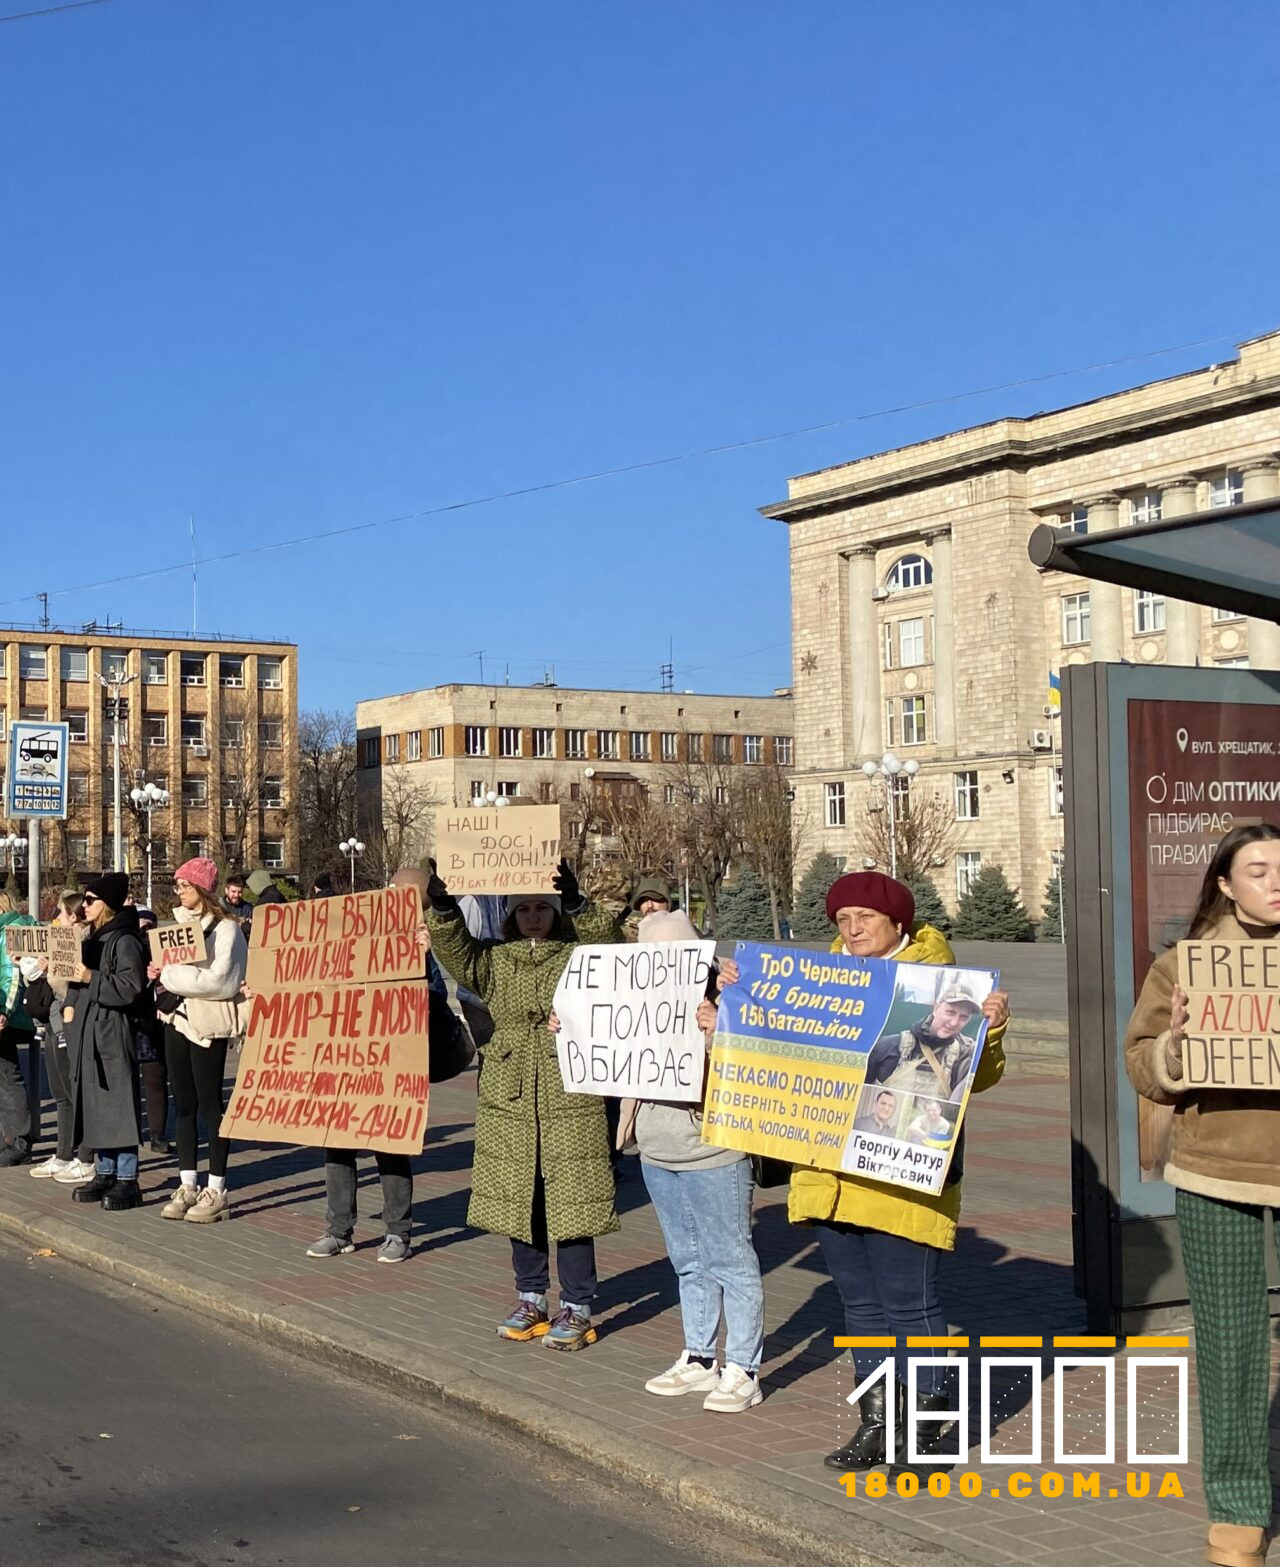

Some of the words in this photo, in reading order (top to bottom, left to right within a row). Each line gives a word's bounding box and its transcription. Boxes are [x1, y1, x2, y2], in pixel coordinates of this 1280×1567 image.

[1191, 741, 1216, 754] ВУЛ.
[1218, 741, 1276, 756] ХРЕЩАТИК,
[34, 800, 41, 808] 10
[1173, 781, 1205, 805] ДІМ
[447, 809, 498, 833] НАШІ
[480, 826, 533, 850] ДОСІ
[1148, 812, 1234, 836] ПІДБИРАЄ
[449, 853, 465, 870] В
[261, 899, 329, 947] РОСІЯ
[342, 887, 417, 938] ВБИВЦЯ
[158, 927, 195, 949] FREE
[162, 945, 197, 965] AZOV
[272, 945, 320, 984] КОЛИ
[320, 938, 357, 981] БУДЕ
[368, 934, 421, 976] КАРА
[565, 954, 601, 989] НЕ
[614, 948, 710, 991] МОВЧІТЬ
[760, 953, 795, 979] ТрО
[799, 958, 872, 987] Черкаси
[1187, 945, 1279, 988] FREE
[751, 980, 801, 1000] 118
[785, 986, 865, 1017] бригада
[591, 1000, 687, 1040] ПОЛОН
[739, 1003, 765, 1028] 156
[767, 1008, 863, 1041] батальйон
[263, 1041, 297, 1067] ЦЕ
[313, 1041, 391, 1067] ГАНЬБА
[567, 1040, 692, 1087] ВБИВАЄ
[242, 1069, 256, 1090] В
[713, 1061, 788, 1090] ЧЕКАЄМО
[791, 1074, 859, 1102] ДОДОМУ!
[711, 1088, 786, 1115] ПОВЕРНІТЬ
[790, 1102, 798, 1119] З
[802, 1105, 850, 1127] ПОЛОНУ
[707, 1110, 755, 1134] БАТЬКА,
[758, 1121, 812, 1146] ЧОЛОВІКА,
[814, 1131, 845, 1149] СИНА!
[853, 1135, 900, 1161] Георгіу
[903, 1147, 943, 1171] Артур
[857, 1155, 933, 1186] Вікторович
